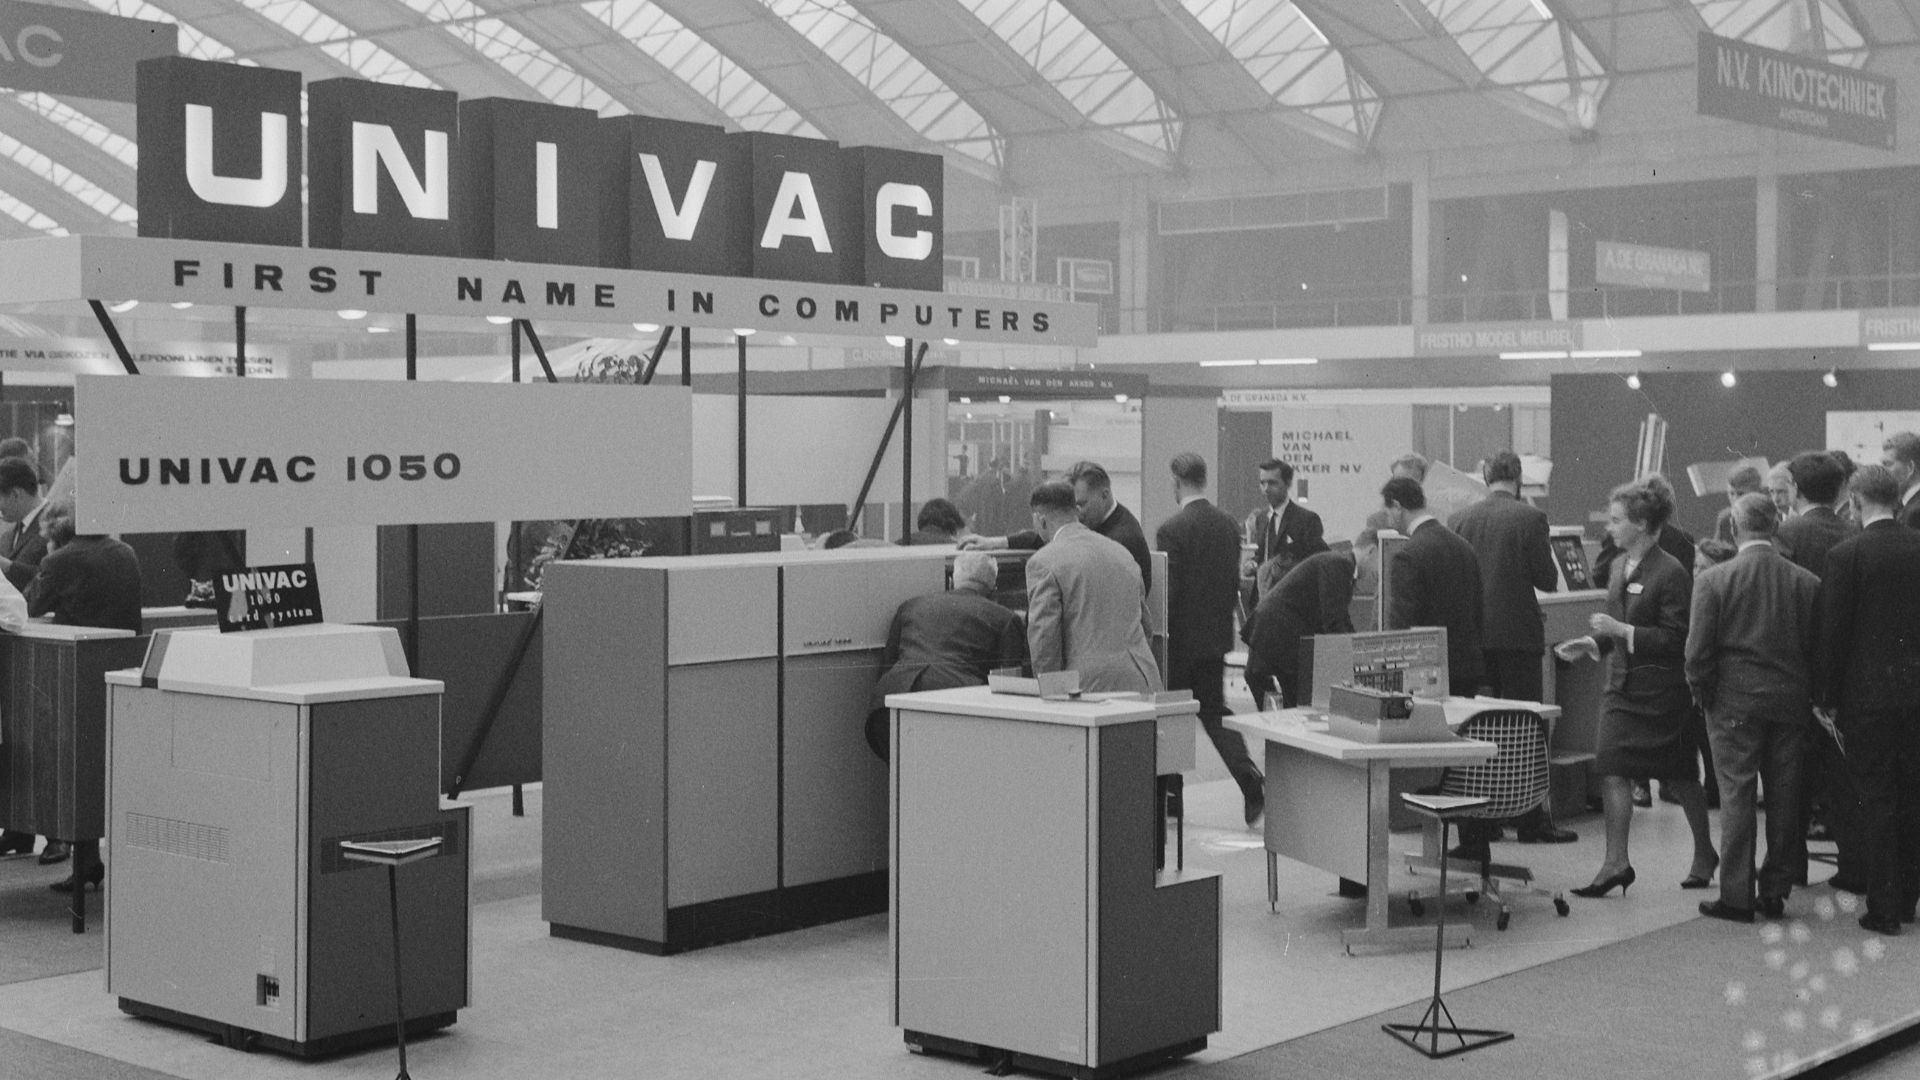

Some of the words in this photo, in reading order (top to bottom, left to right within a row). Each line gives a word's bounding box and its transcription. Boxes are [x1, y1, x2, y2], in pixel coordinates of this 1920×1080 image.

[1717, 46, 1750, 90] N.V.
[1758, 56, 1886, 120] KINOTECHNIEK
[185, 102, 933, 261] UNIVAC
[173, 259, 383, 295] FIRST
[456, 276, 616, 308] NAME
[667, 288, 715, 315] IN
[758, 293, 1050, 333] COMPUTERS
[1864, 318, 1920, 337] FRISTH
[1420, 331, 1473, 349] FRISTHO
[1475, 330, 1519, 347] MODEL
[24, 350, 45, 359] VIA
[1024, 378, 1041, 387] VAN
[1282, 431, 1353, 441] MICHAEL
[1283, 442, 1311, 452] VAN
[1283, 454, 1313, 463] DEN
[118, 455, 317, 486] UNIVAC
[346, 452, 462, 482] 1050
[1292, 464, 1331, 474] KKER
[222, 569, 308, 593] UNIVAC
[250, 592, 281, 606] 1050
[269, 608, 314, 622] system
